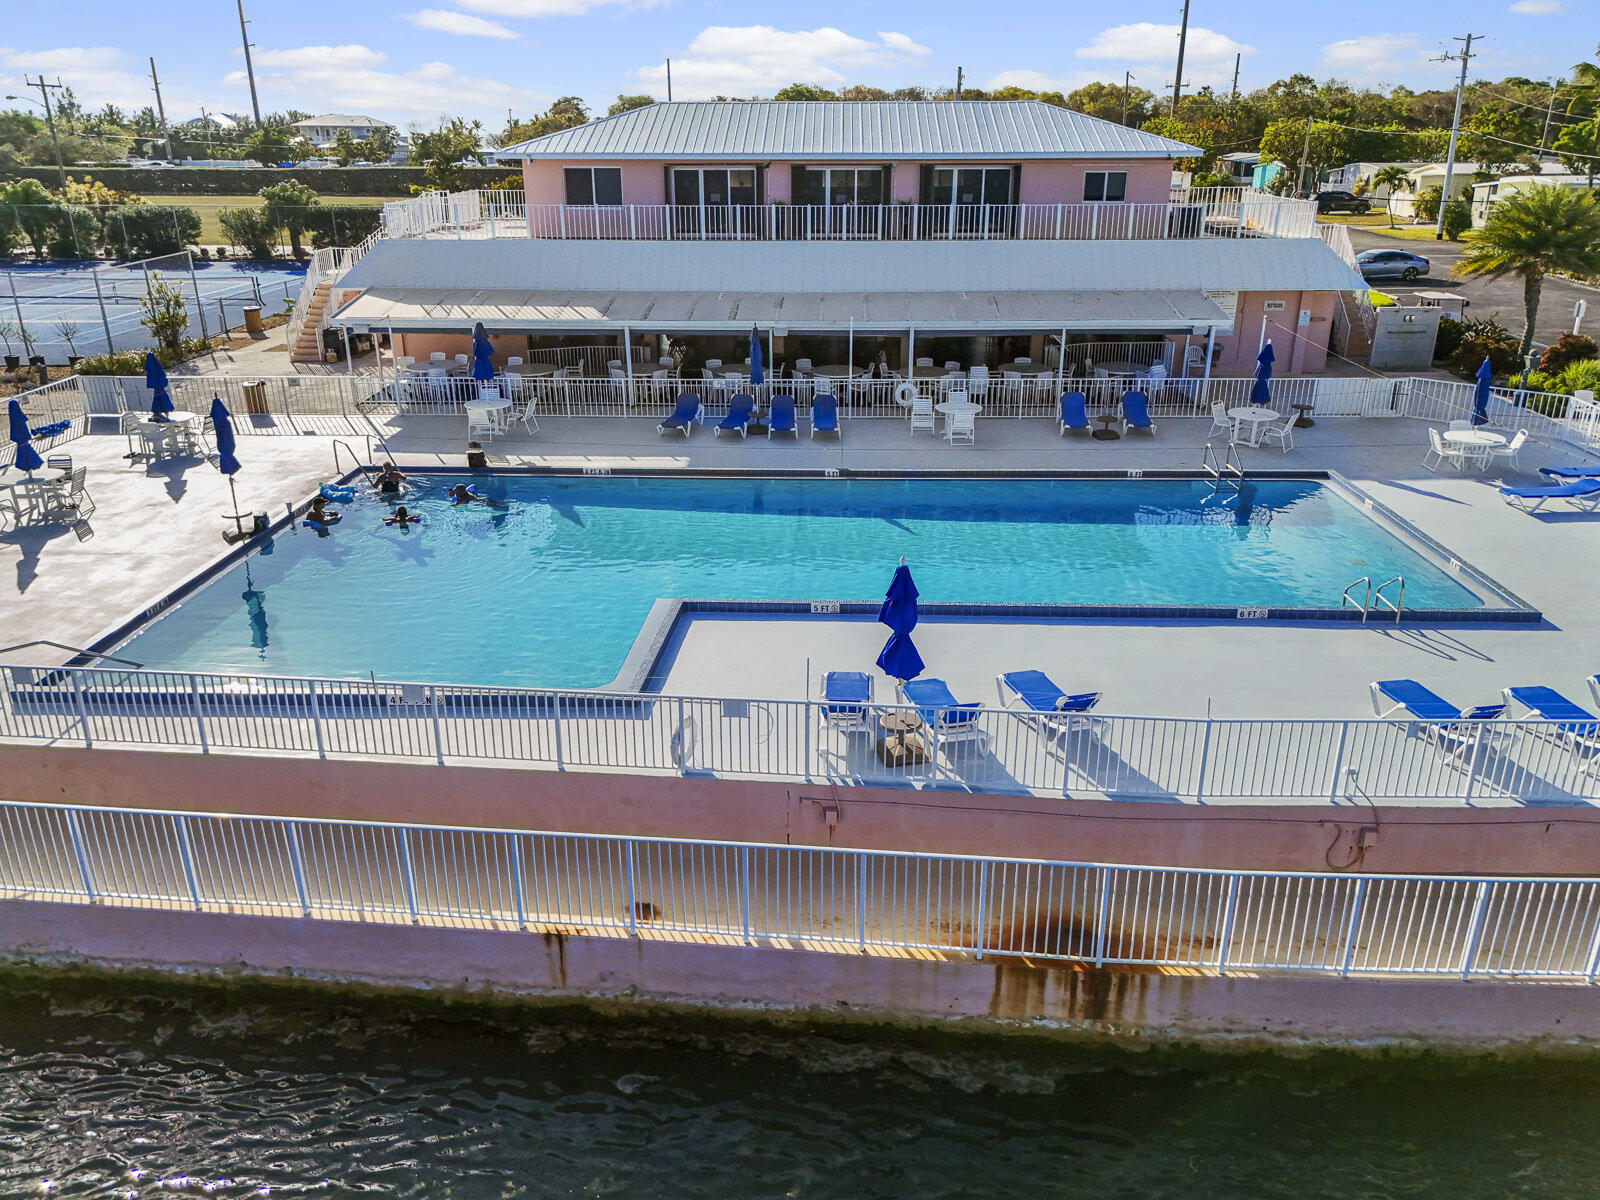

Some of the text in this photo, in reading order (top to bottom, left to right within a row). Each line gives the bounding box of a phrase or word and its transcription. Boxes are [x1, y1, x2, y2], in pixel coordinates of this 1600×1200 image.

[813, 604, 830, 612] 5 FT
[1239, 610, 1257, 618] 6 FT
[390, 696, 396, 704] 4
